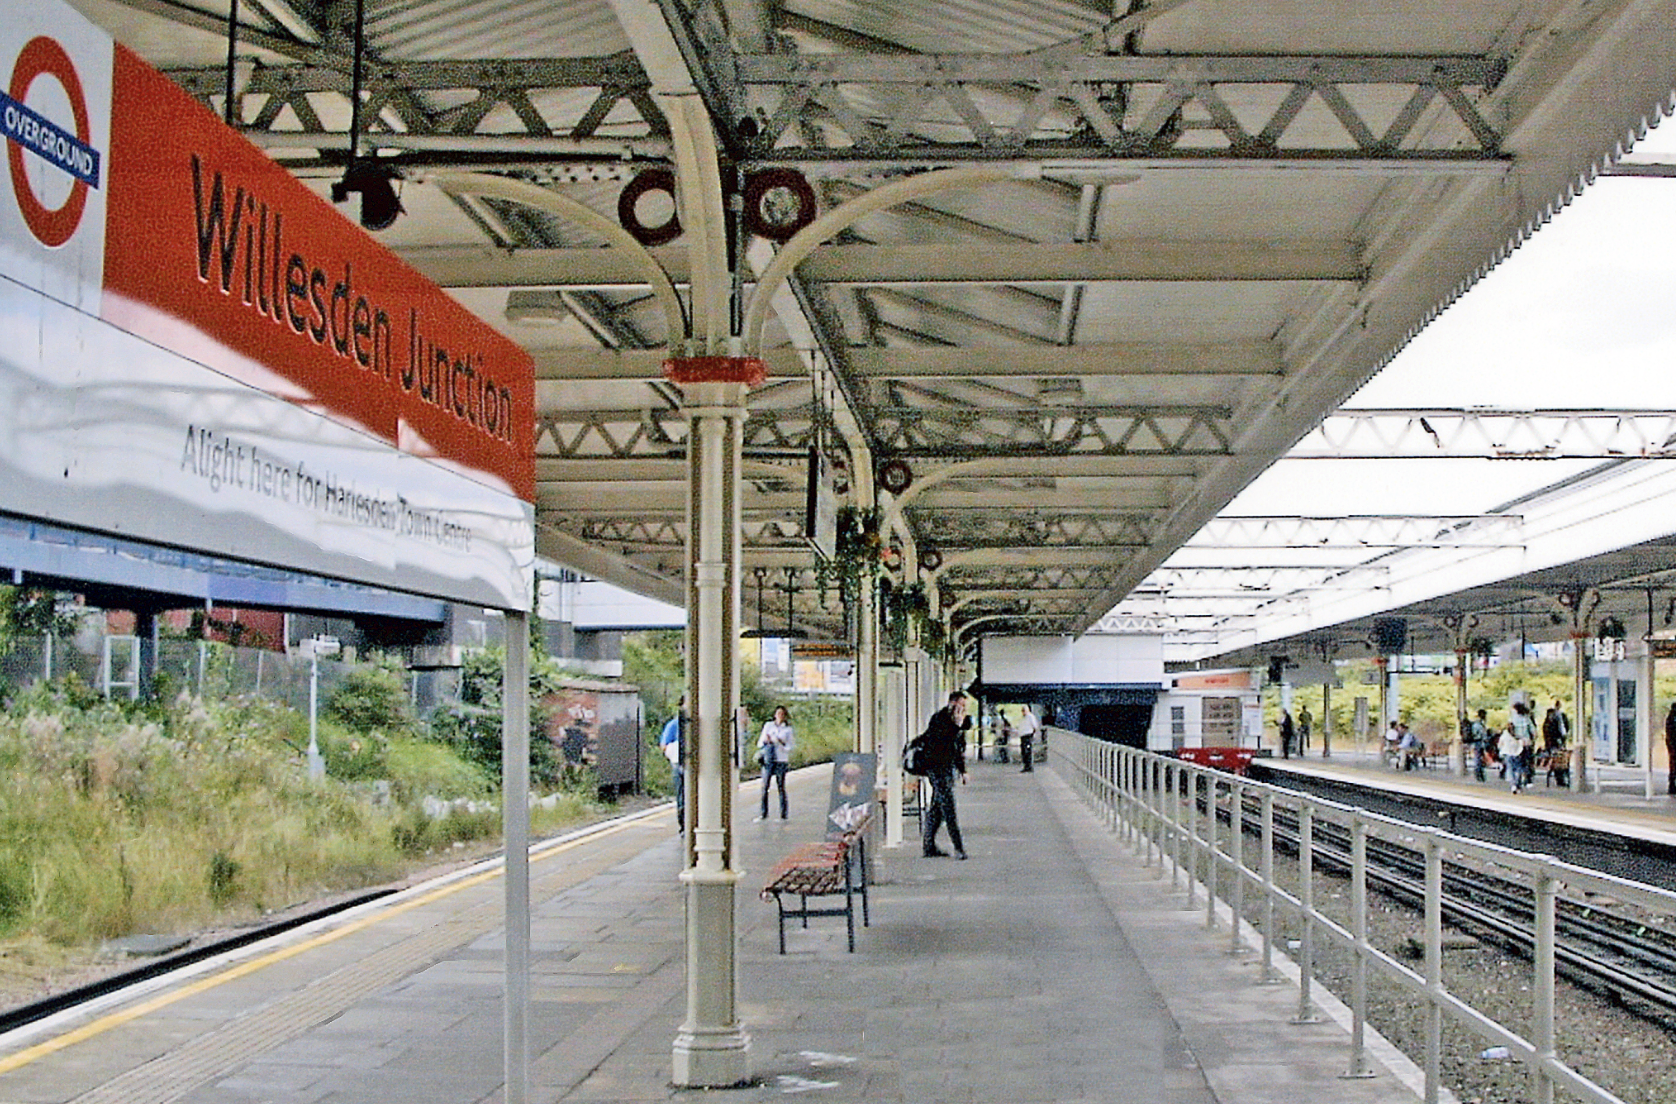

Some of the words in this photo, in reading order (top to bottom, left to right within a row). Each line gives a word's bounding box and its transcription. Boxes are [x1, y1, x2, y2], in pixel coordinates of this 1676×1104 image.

[5, 106, 93, 176] OVERGROUND
[191, 153, 392, 382] Willesden
[401, 306, 512, 445] Junction
[181, 424, 245, 493] Alight
[250, 446, 291, 502] here
[296, 460, 322, 509] for
[325, 470, 396, 530] Harlesden
[398, 492, 432, 540] Town
